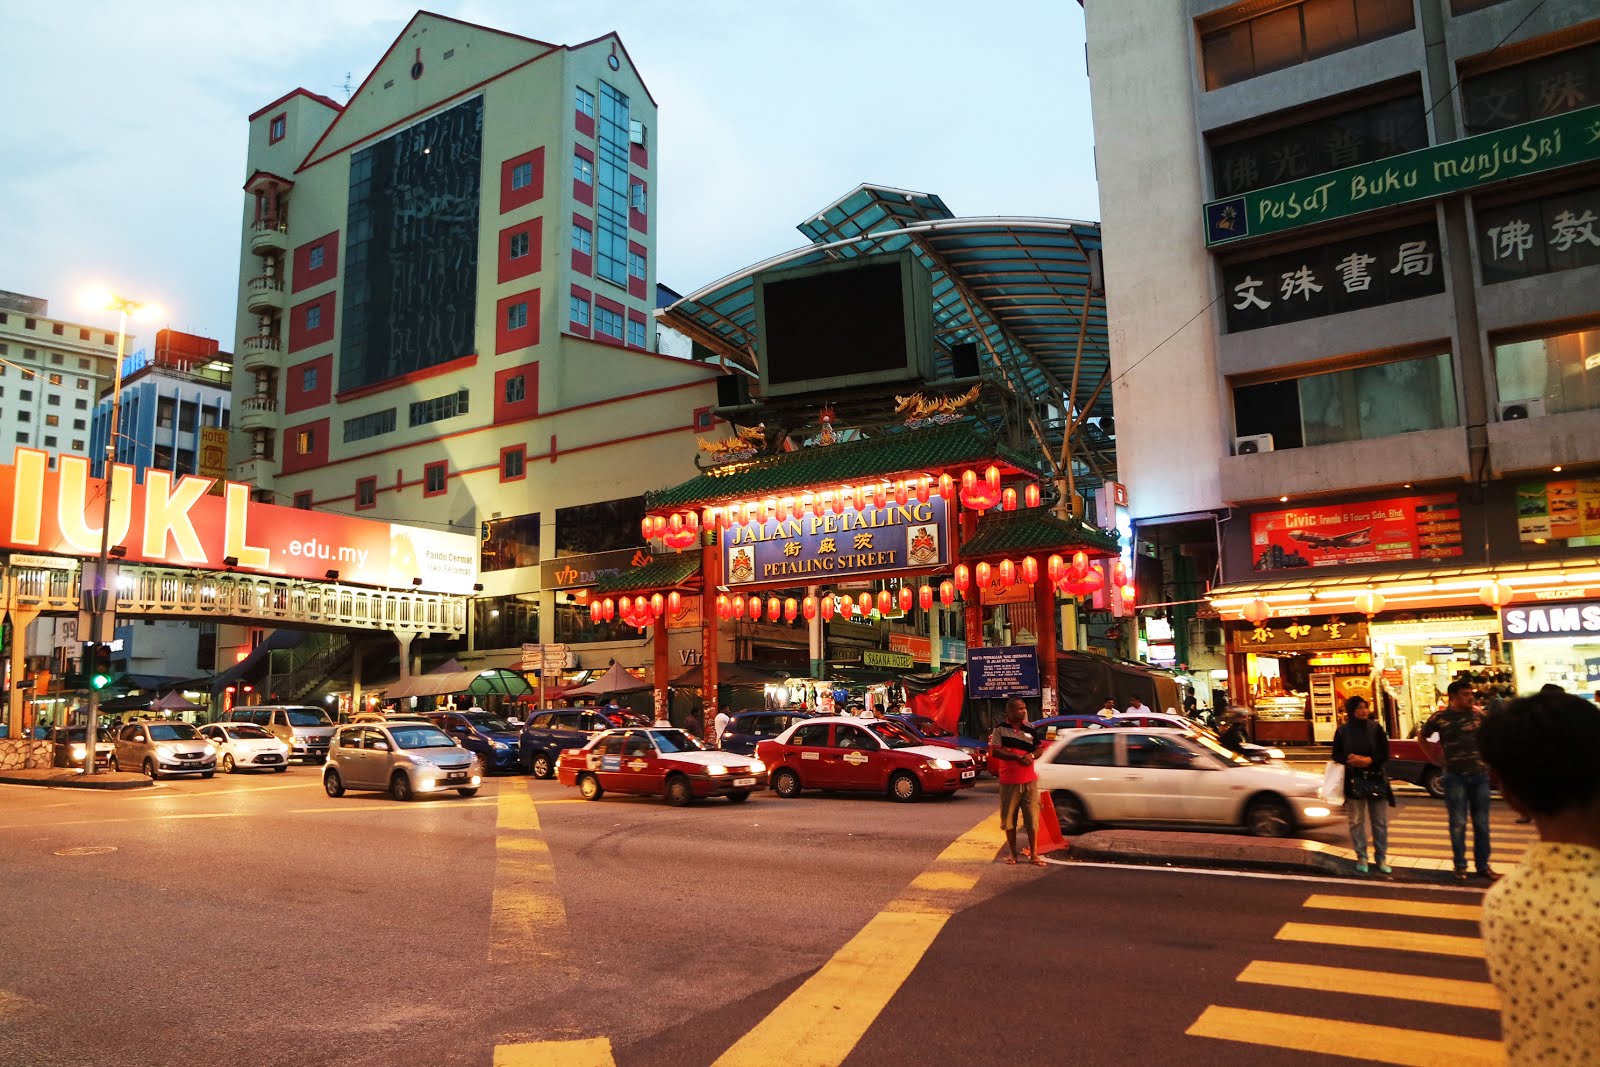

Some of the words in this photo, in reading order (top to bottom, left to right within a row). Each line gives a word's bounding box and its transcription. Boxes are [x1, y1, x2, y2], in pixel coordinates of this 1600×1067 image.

[1487, 210, 1600, 261] 佛教
[1233, 241, 1435, 311] 文殊書局
[202, 431, 228, 445] HOTEL
[11, 446, 271, 570] IUKL
[281, 538, 369, 568] .edu.my
[732, 518, 805, 545] JALAN
[809, 502, 934, 535] PETALING
[1284, 513, 1317, 528] Civic
[1350, 512, 1370, 521] Tours
[448, 553, 473, 565] Cermat
[764, 557, 834, 577] PETALING
[838, 550, 897, 571] STREET
[1535, 588, 1586, 600] WELCOME
[1278, 607, 1311, 617] DATANG
[868, 652, 891, 666] SASANA
[893, 655, 910, 668] HOTEL
